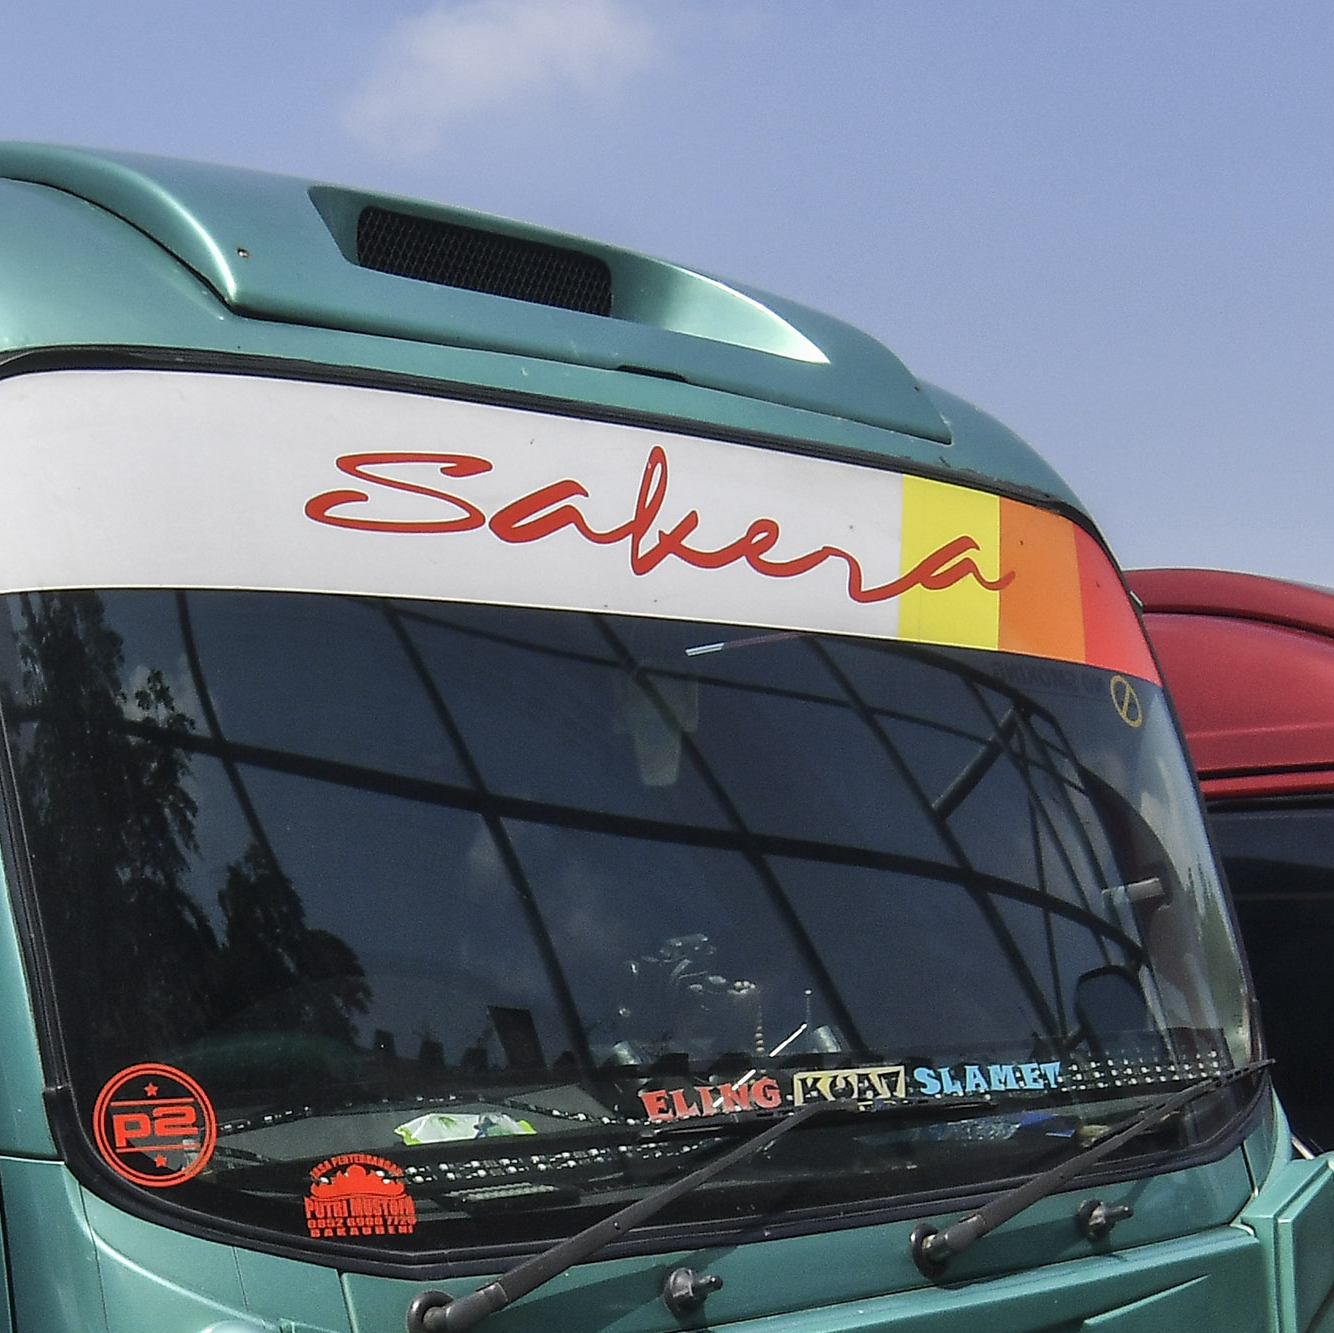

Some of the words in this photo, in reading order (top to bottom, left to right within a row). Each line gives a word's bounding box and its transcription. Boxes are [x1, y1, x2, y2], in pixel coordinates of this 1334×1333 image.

[306, 444, 1017, 604] Sakera
[640, 1077, 783, 1122] ELING
[913, 1061, 1061, 1096] SLAMET
[304, 1197, 348, 1219] PUTRI
